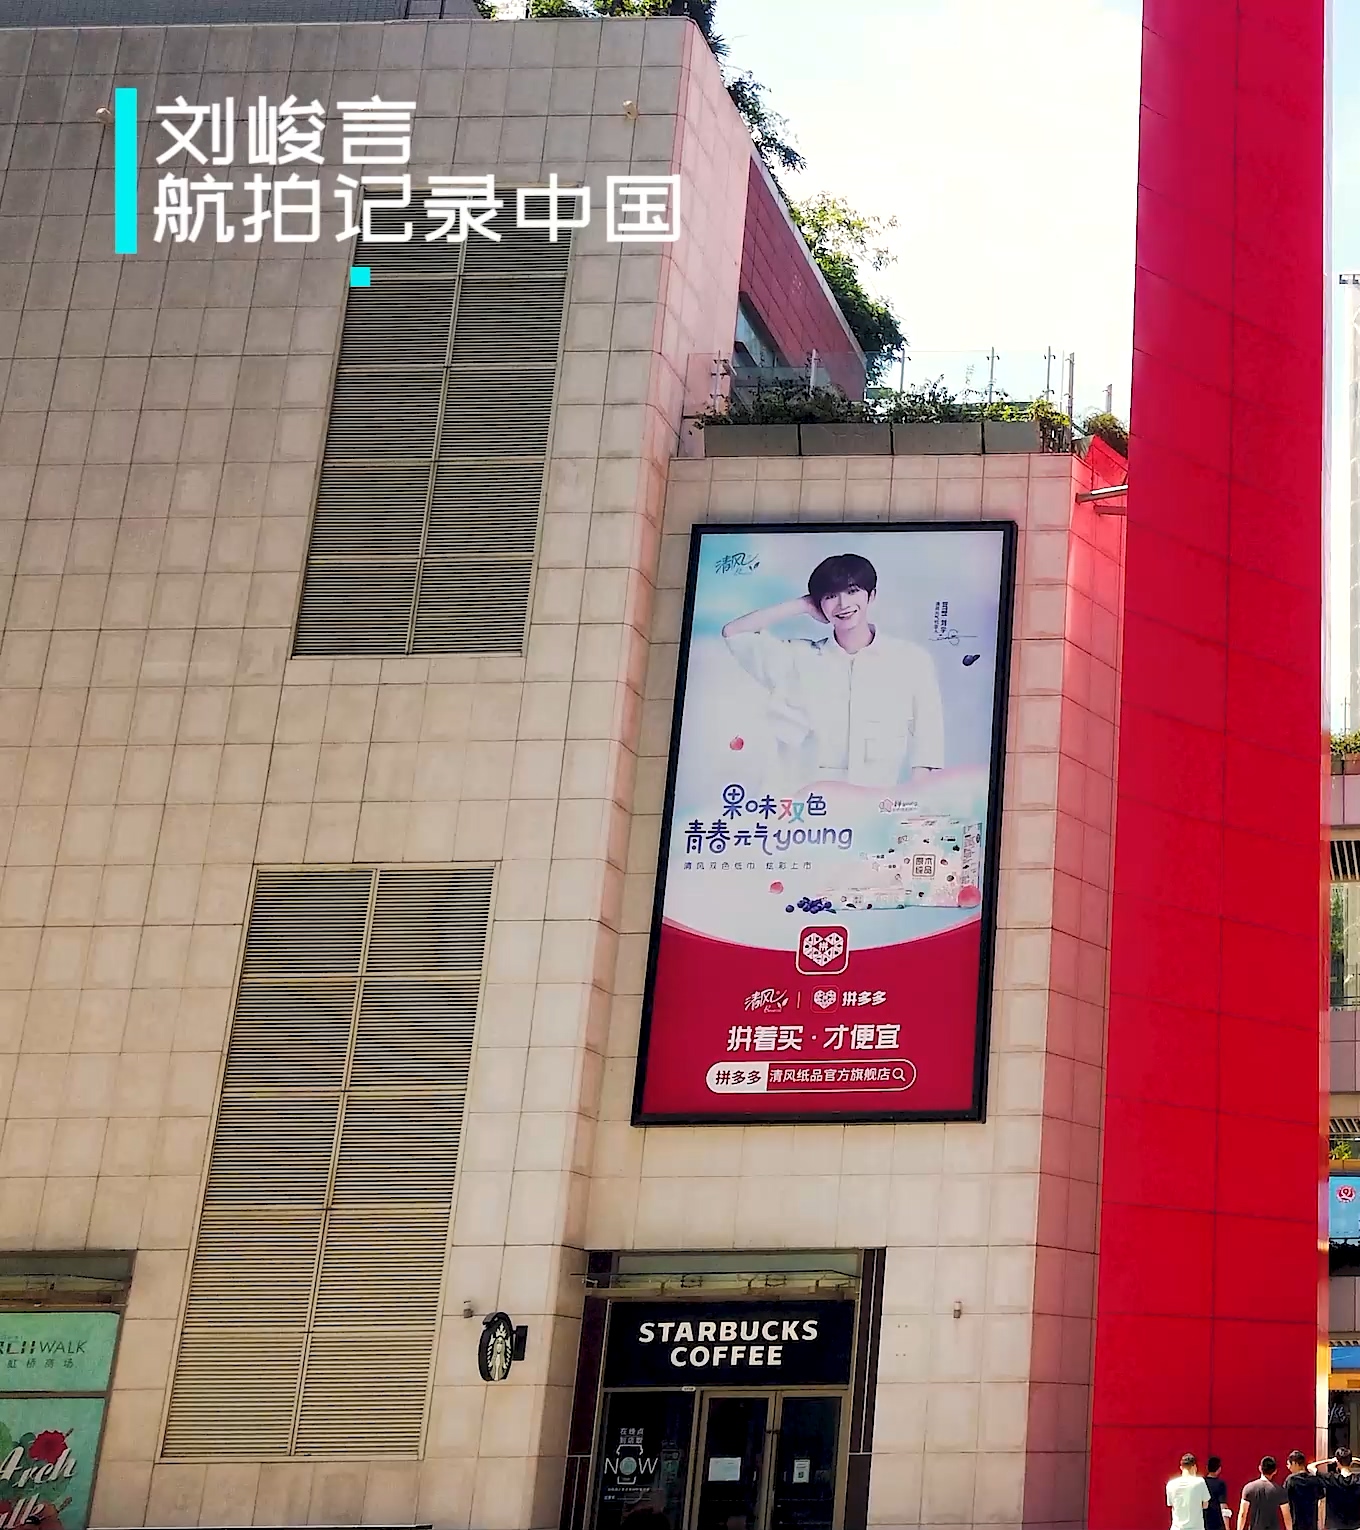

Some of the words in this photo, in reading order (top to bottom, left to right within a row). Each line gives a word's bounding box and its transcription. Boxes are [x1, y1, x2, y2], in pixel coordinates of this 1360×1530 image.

[722, 783, 828, 823] 果味双色
[744, 988, 789, 1011] 清风
[841, 990, 888, 1008] 拼多多
[715, 1069, 762, 1087] 拼多多
[769, 1066, 892, 1083] 清风纸品官方旗舰店
[638, 1319, 819, 1343] STARBUCKS
[40, 1340, 88, 1354] WALK
[670, 1345, 783, 1368] COFFEE
